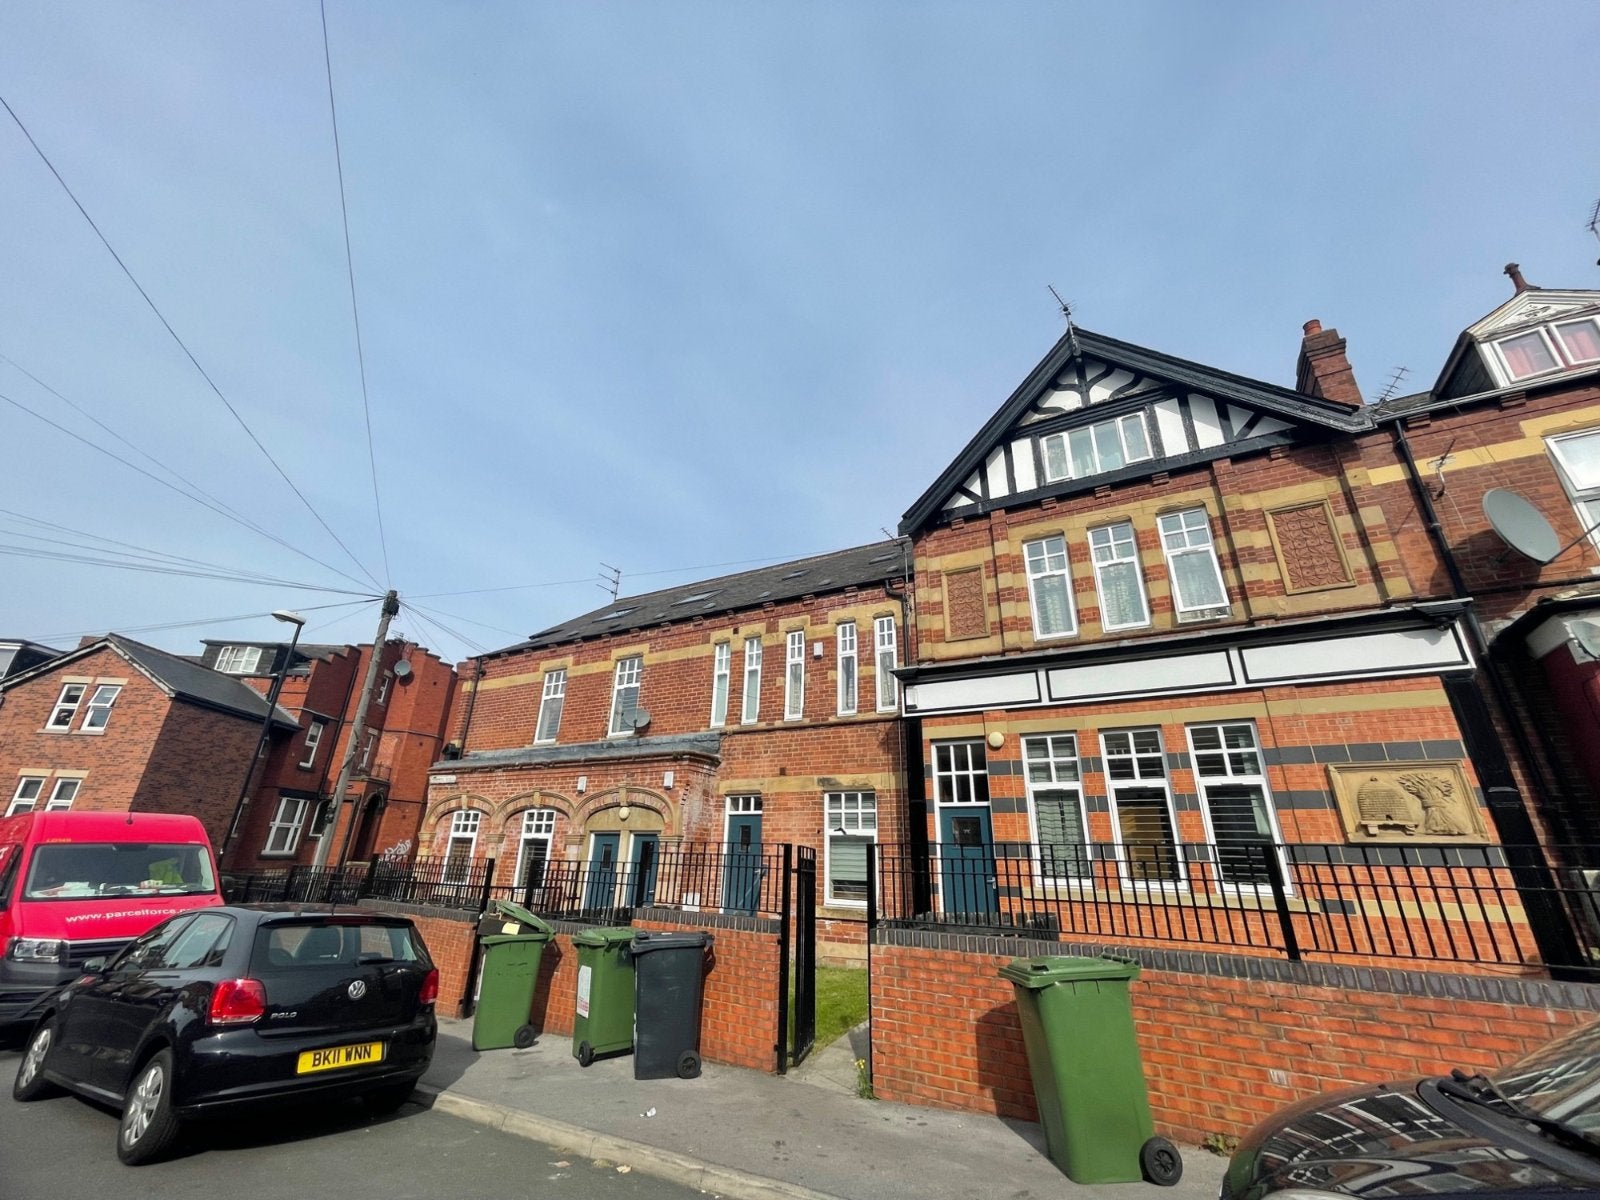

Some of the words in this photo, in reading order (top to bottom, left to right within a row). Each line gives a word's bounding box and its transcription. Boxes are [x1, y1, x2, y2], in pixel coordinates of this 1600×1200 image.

[65, 908, 191, 923] www.parcelforce.c
[270, 1011, 297, 1019] POLO
[312, 1048, 340, 1067] BK11
[345, 1044, 372, 1062] WNN
